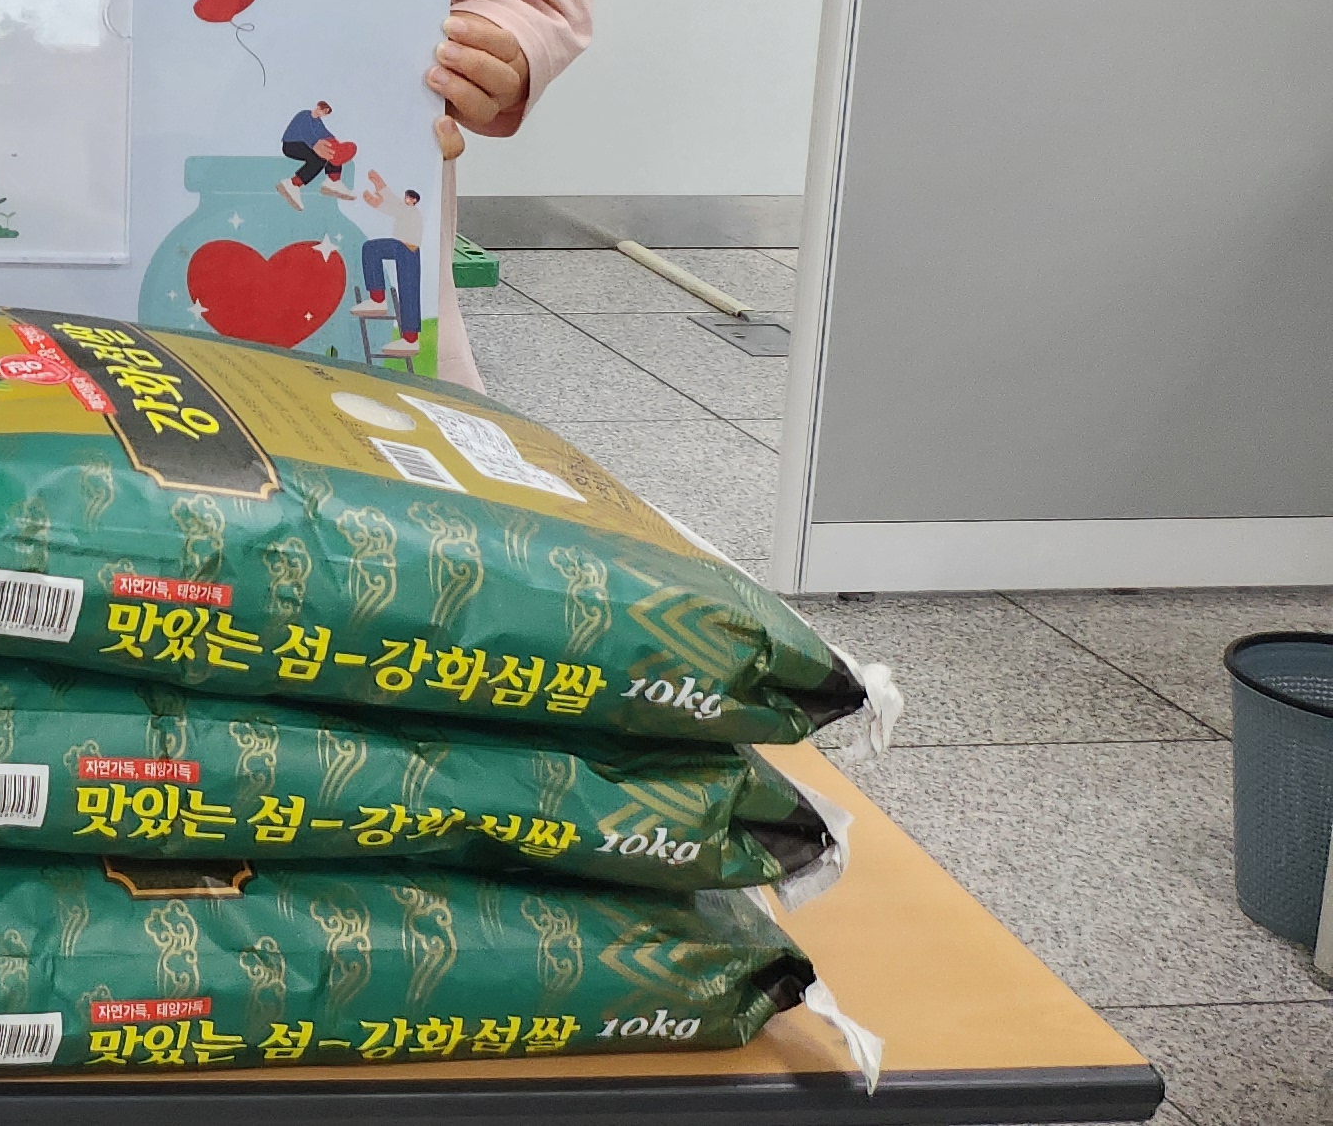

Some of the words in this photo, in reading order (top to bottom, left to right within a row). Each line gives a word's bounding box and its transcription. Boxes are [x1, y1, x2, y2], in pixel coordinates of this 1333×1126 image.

[52, 322, 221, 441] 강화섬쌀
[99, 602, 260, 671] 맛있는
[271, 624, 608, 716] 섬-강화섬쌀
[620, 675, 724, 721] 10kg
[73, 782, 237, 841] 맛있는
[595, 827, 701, 864] 10kg
[88, 1020, 249, 1065] 맛있는
[256, 1016, 582, 1060] 섬-강화섬쌀
[596, 1008, 702, 1041] 10kg
